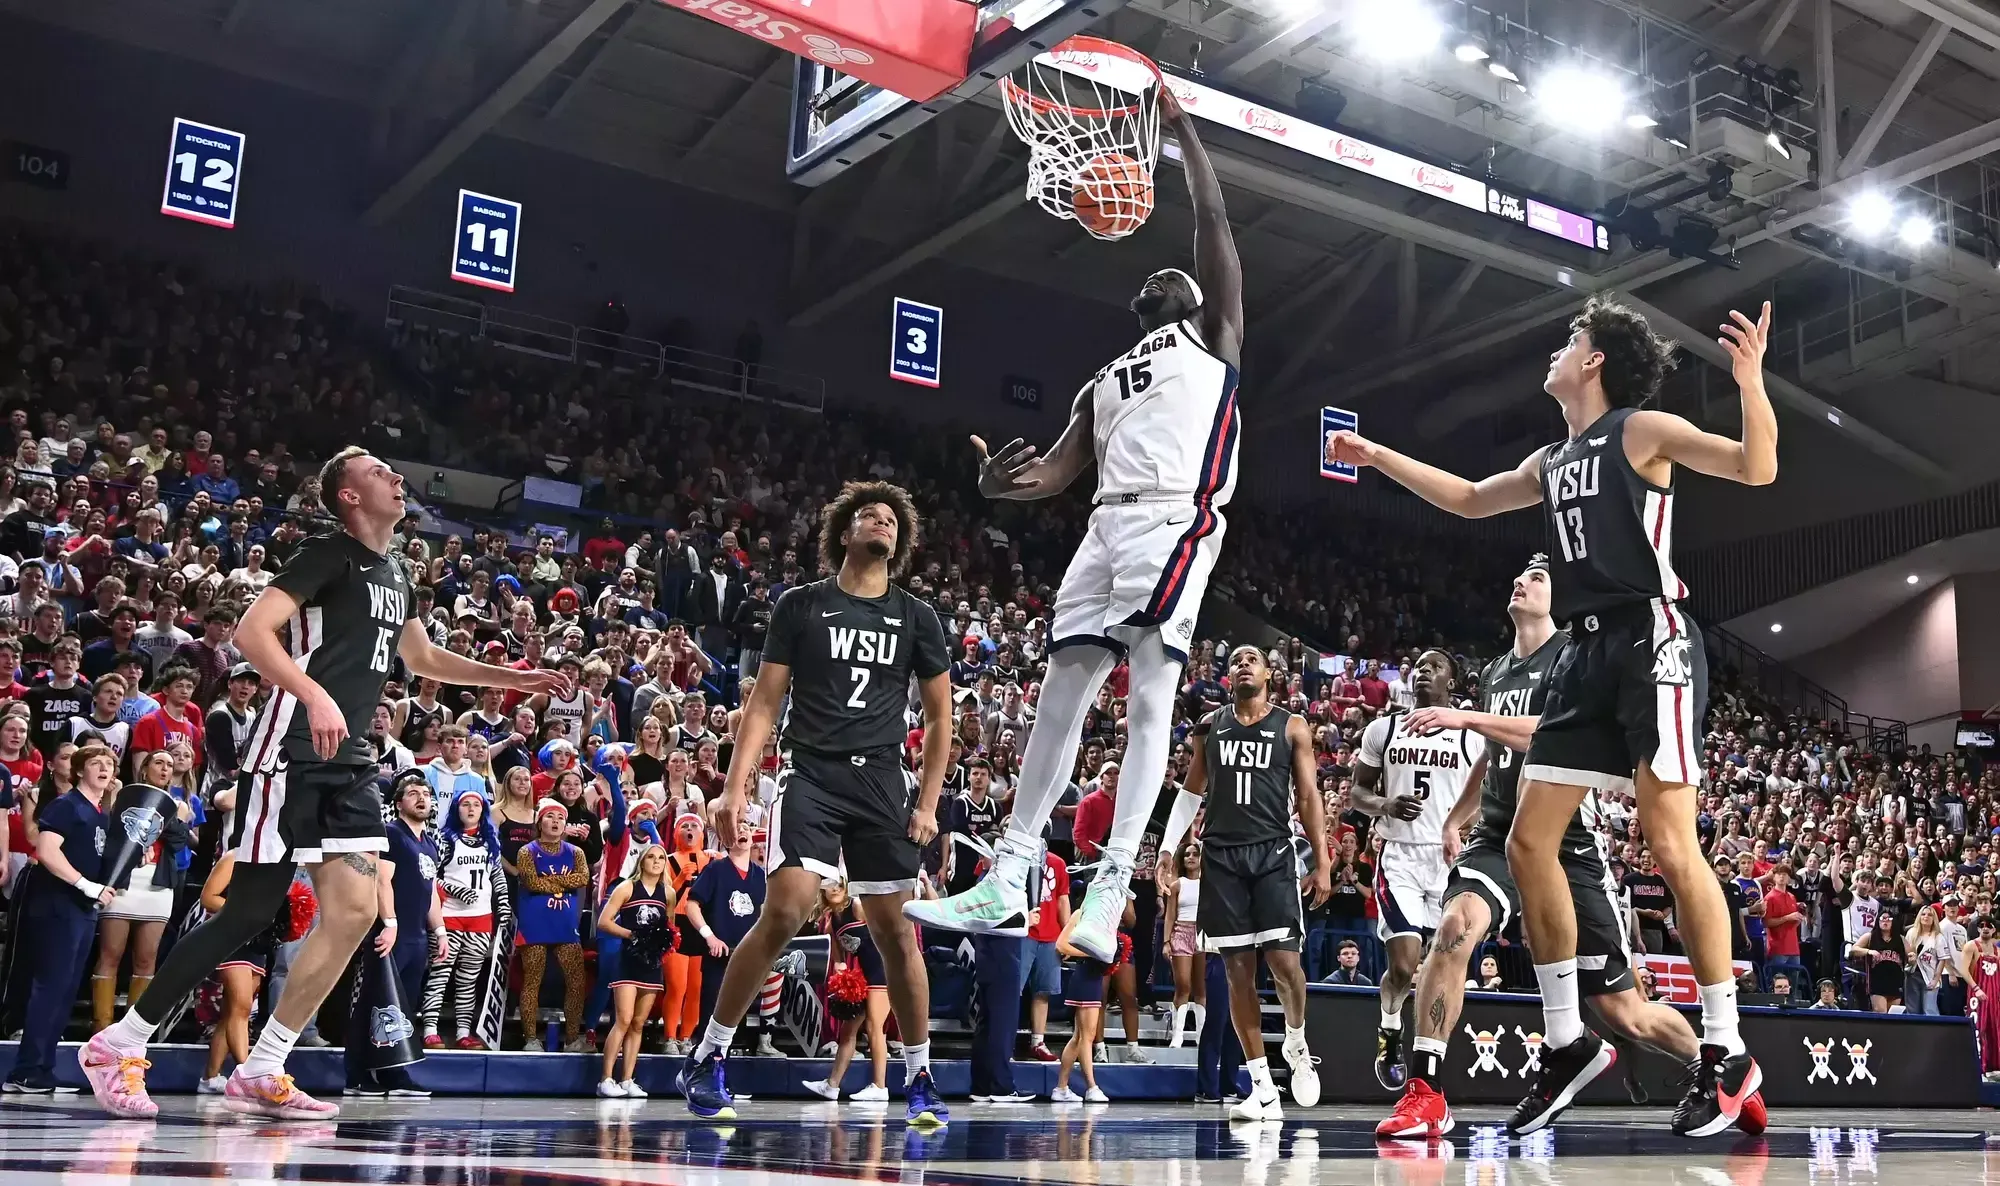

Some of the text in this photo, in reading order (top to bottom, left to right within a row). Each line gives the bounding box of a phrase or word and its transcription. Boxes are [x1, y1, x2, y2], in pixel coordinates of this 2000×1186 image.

[185, 134, 231, 151] STOCKTON
[18, 154, 59, 179] 104
[175, 152, 235, 193] 12
[467, 222, 509, 257] 11
[902, 311, 934, 323] MORRISON
[906, 327, 927, 354] 3
[1012, 385, 1037, 402] 106
[1114, 360, 1152, 401] 15
[1547, 456, 1600, 506] WSU
[1554, 506, 1588, 563] 13
[366, 581, 406, 626] WSU
[370, 626, 395, 673] 15
[828, 626, 898, 666] WSU
[847, 666, 870, 709] 2
[44, 700, 81, 713] ZAGS
[551, 707, 584, 717] GONZAGA
[1490, 688, 1534, 717] WSU
[1219, 740, 1273, 769] WSU
[1388, 747, 1459, 769] GONZAGA
[1235, 771, 1252, 805] 11
[1414, 770, 1431, 801] 5
[470, 869, 484, 890] 11
[1633, 884, 1665, 897] GONZAGA
[547, 897, 570, 911] CITY
[1861, 913, 1876, 929] 12
